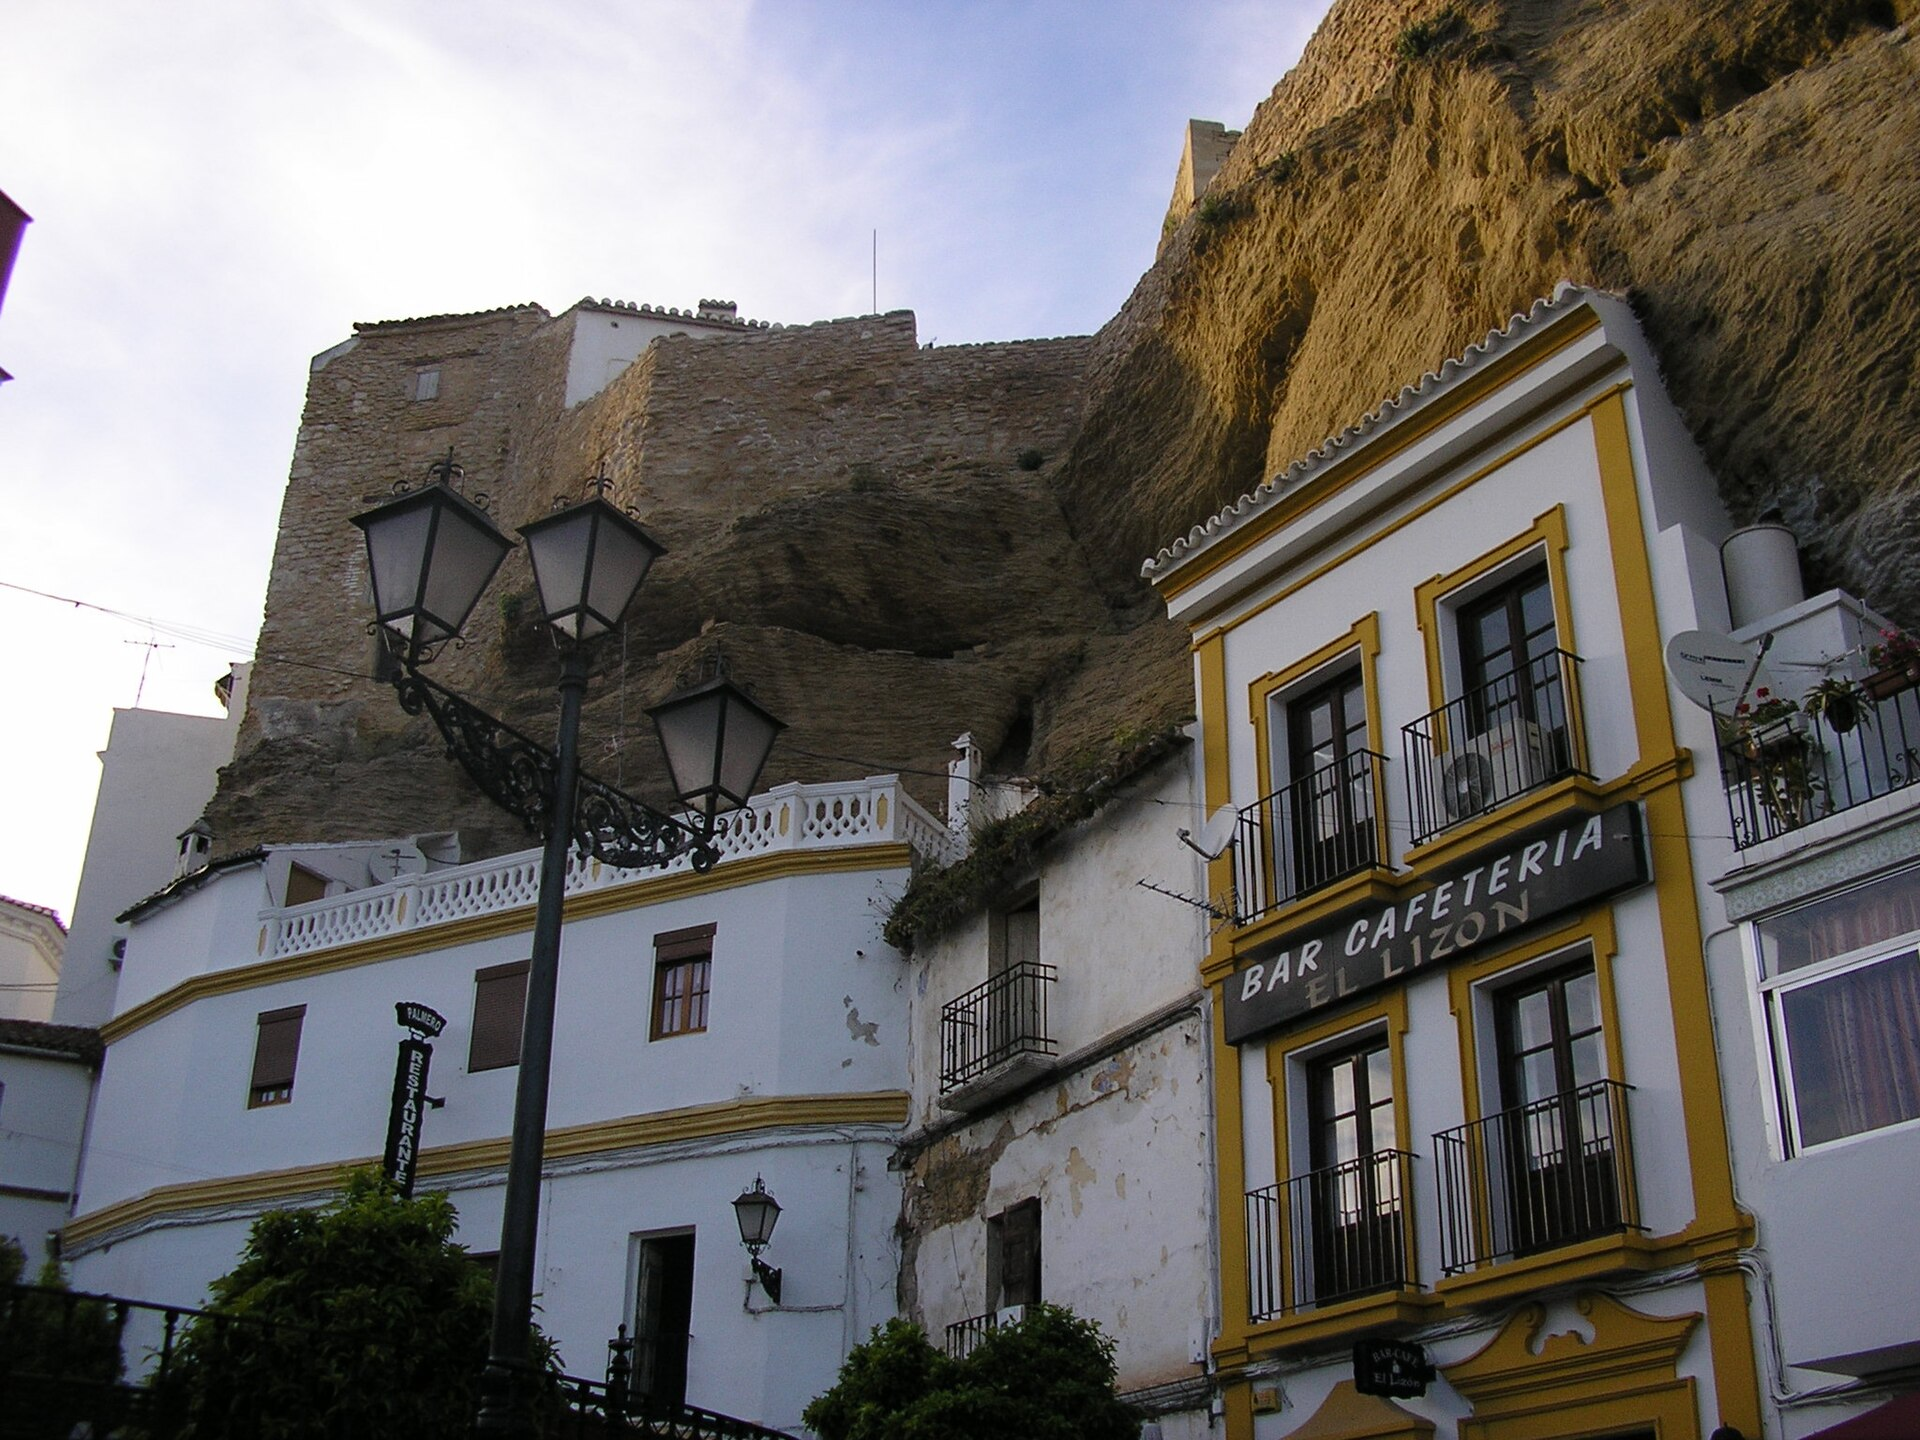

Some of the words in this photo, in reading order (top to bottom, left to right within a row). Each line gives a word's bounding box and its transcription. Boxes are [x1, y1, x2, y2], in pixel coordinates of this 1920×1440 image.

[1240, 938, 1324, 1001] BAR
[1344, 814, 1602, 956] CAFETERIA
[1305, 967, 1358, 1008] EL
[1380, 889, 1530, 979] LIZON
[406, 1006, 443, 1032] PALMERO
[395, 1049, 424, 1186] RESTAURANTE
